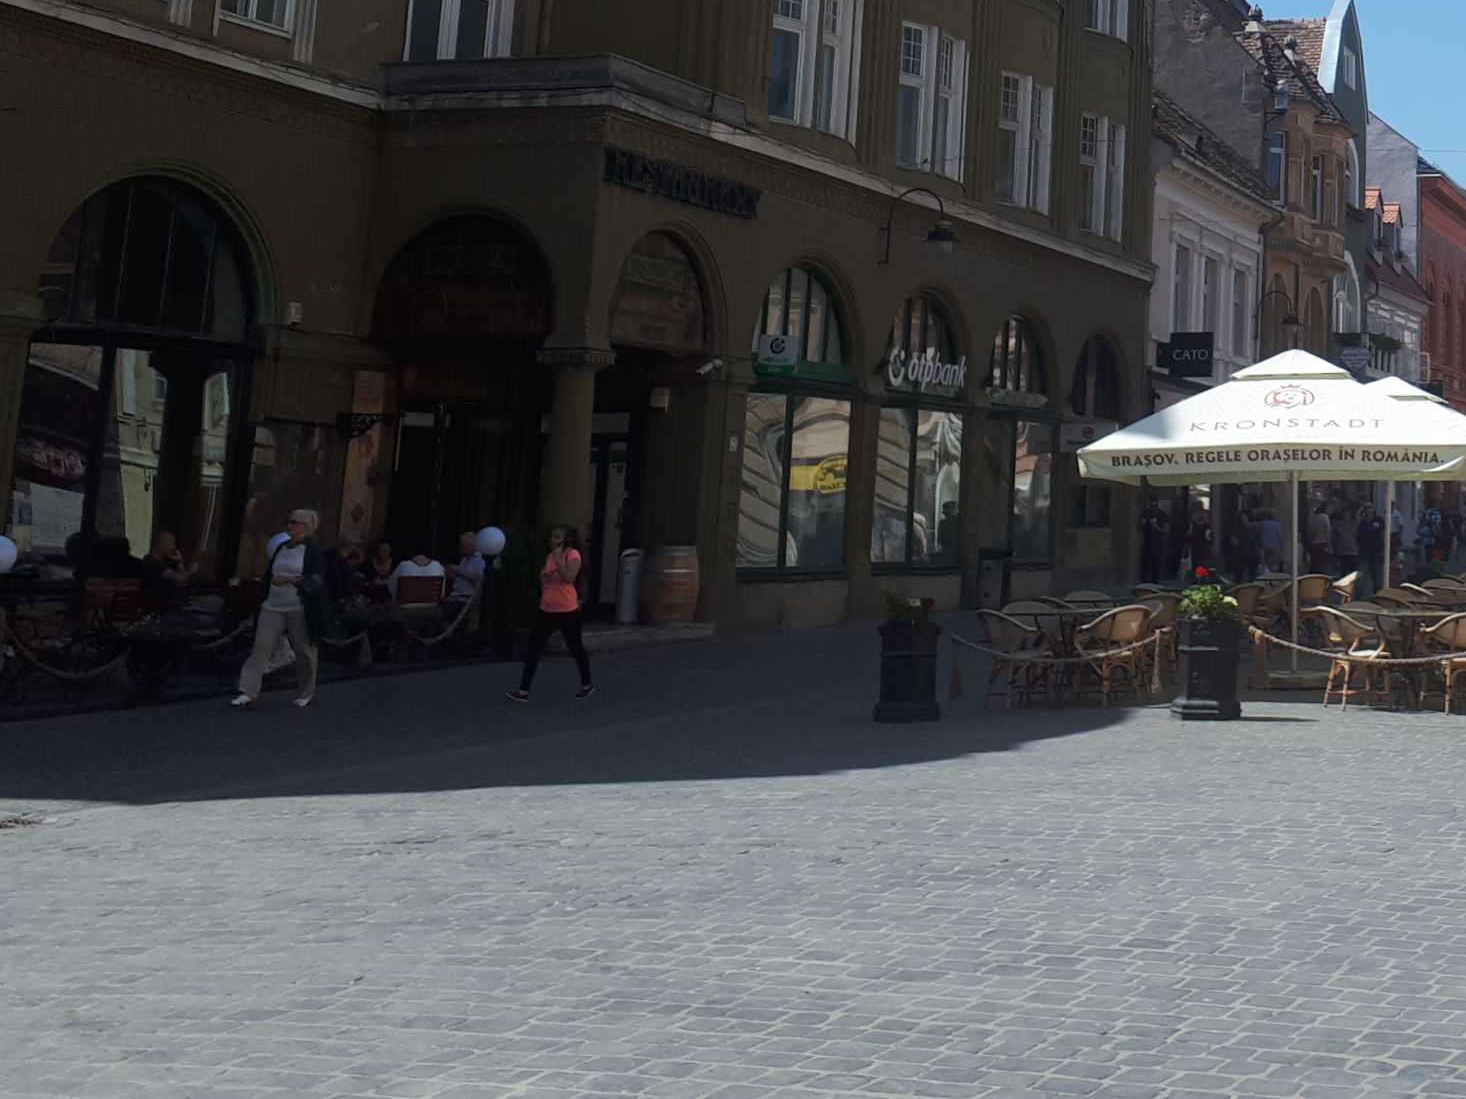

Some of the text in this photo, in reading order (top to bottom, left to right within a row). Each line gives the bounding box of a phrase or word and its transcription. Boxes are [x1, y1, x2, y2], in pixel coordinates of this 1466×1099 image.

[1172, 348, 1209, 361] CATO
[908, 352, 967, 392] otpbank
[1190, 418, 1384, 431] KRONSTADT
[1185, 450, 1242, 465] REGELE
[1247, 448, 1332, 463] ORAȘELOR
[1338, 446, 1356, 460] ÎN
[1361, 448, 1445, 464] ROMÂNIA.
